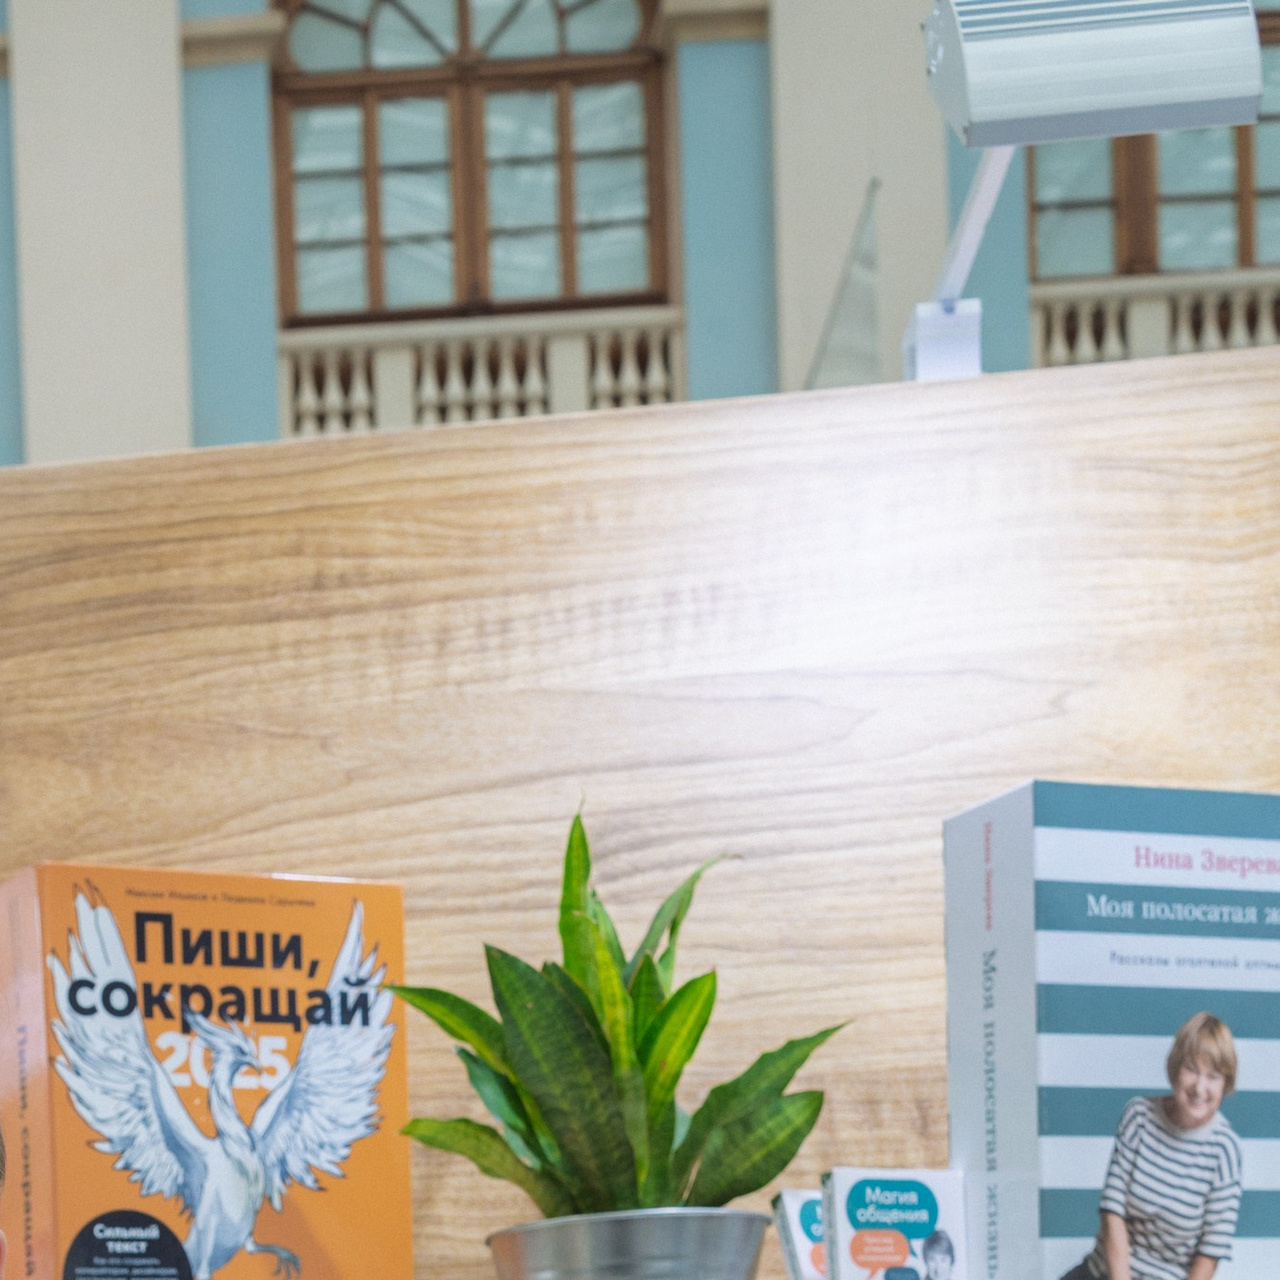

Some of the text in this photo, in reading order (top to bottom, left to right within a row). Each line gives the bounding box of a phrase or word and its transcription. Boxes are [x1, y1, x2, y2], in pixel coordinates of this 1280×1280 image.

[1135, 845, 1193, 871] Нина
[1086, 892, 1135, 920] Моя
[1142, 901, 1258, 925] полосатая
[134, 911, 320, 979] Пиши,
[68, 976, 371, 1035] сокращай
[865, 1187, 919, 1205] Магия
[856, 1204, 930, 1226] общения
[93, 1222, 160, 1240] Сильный
